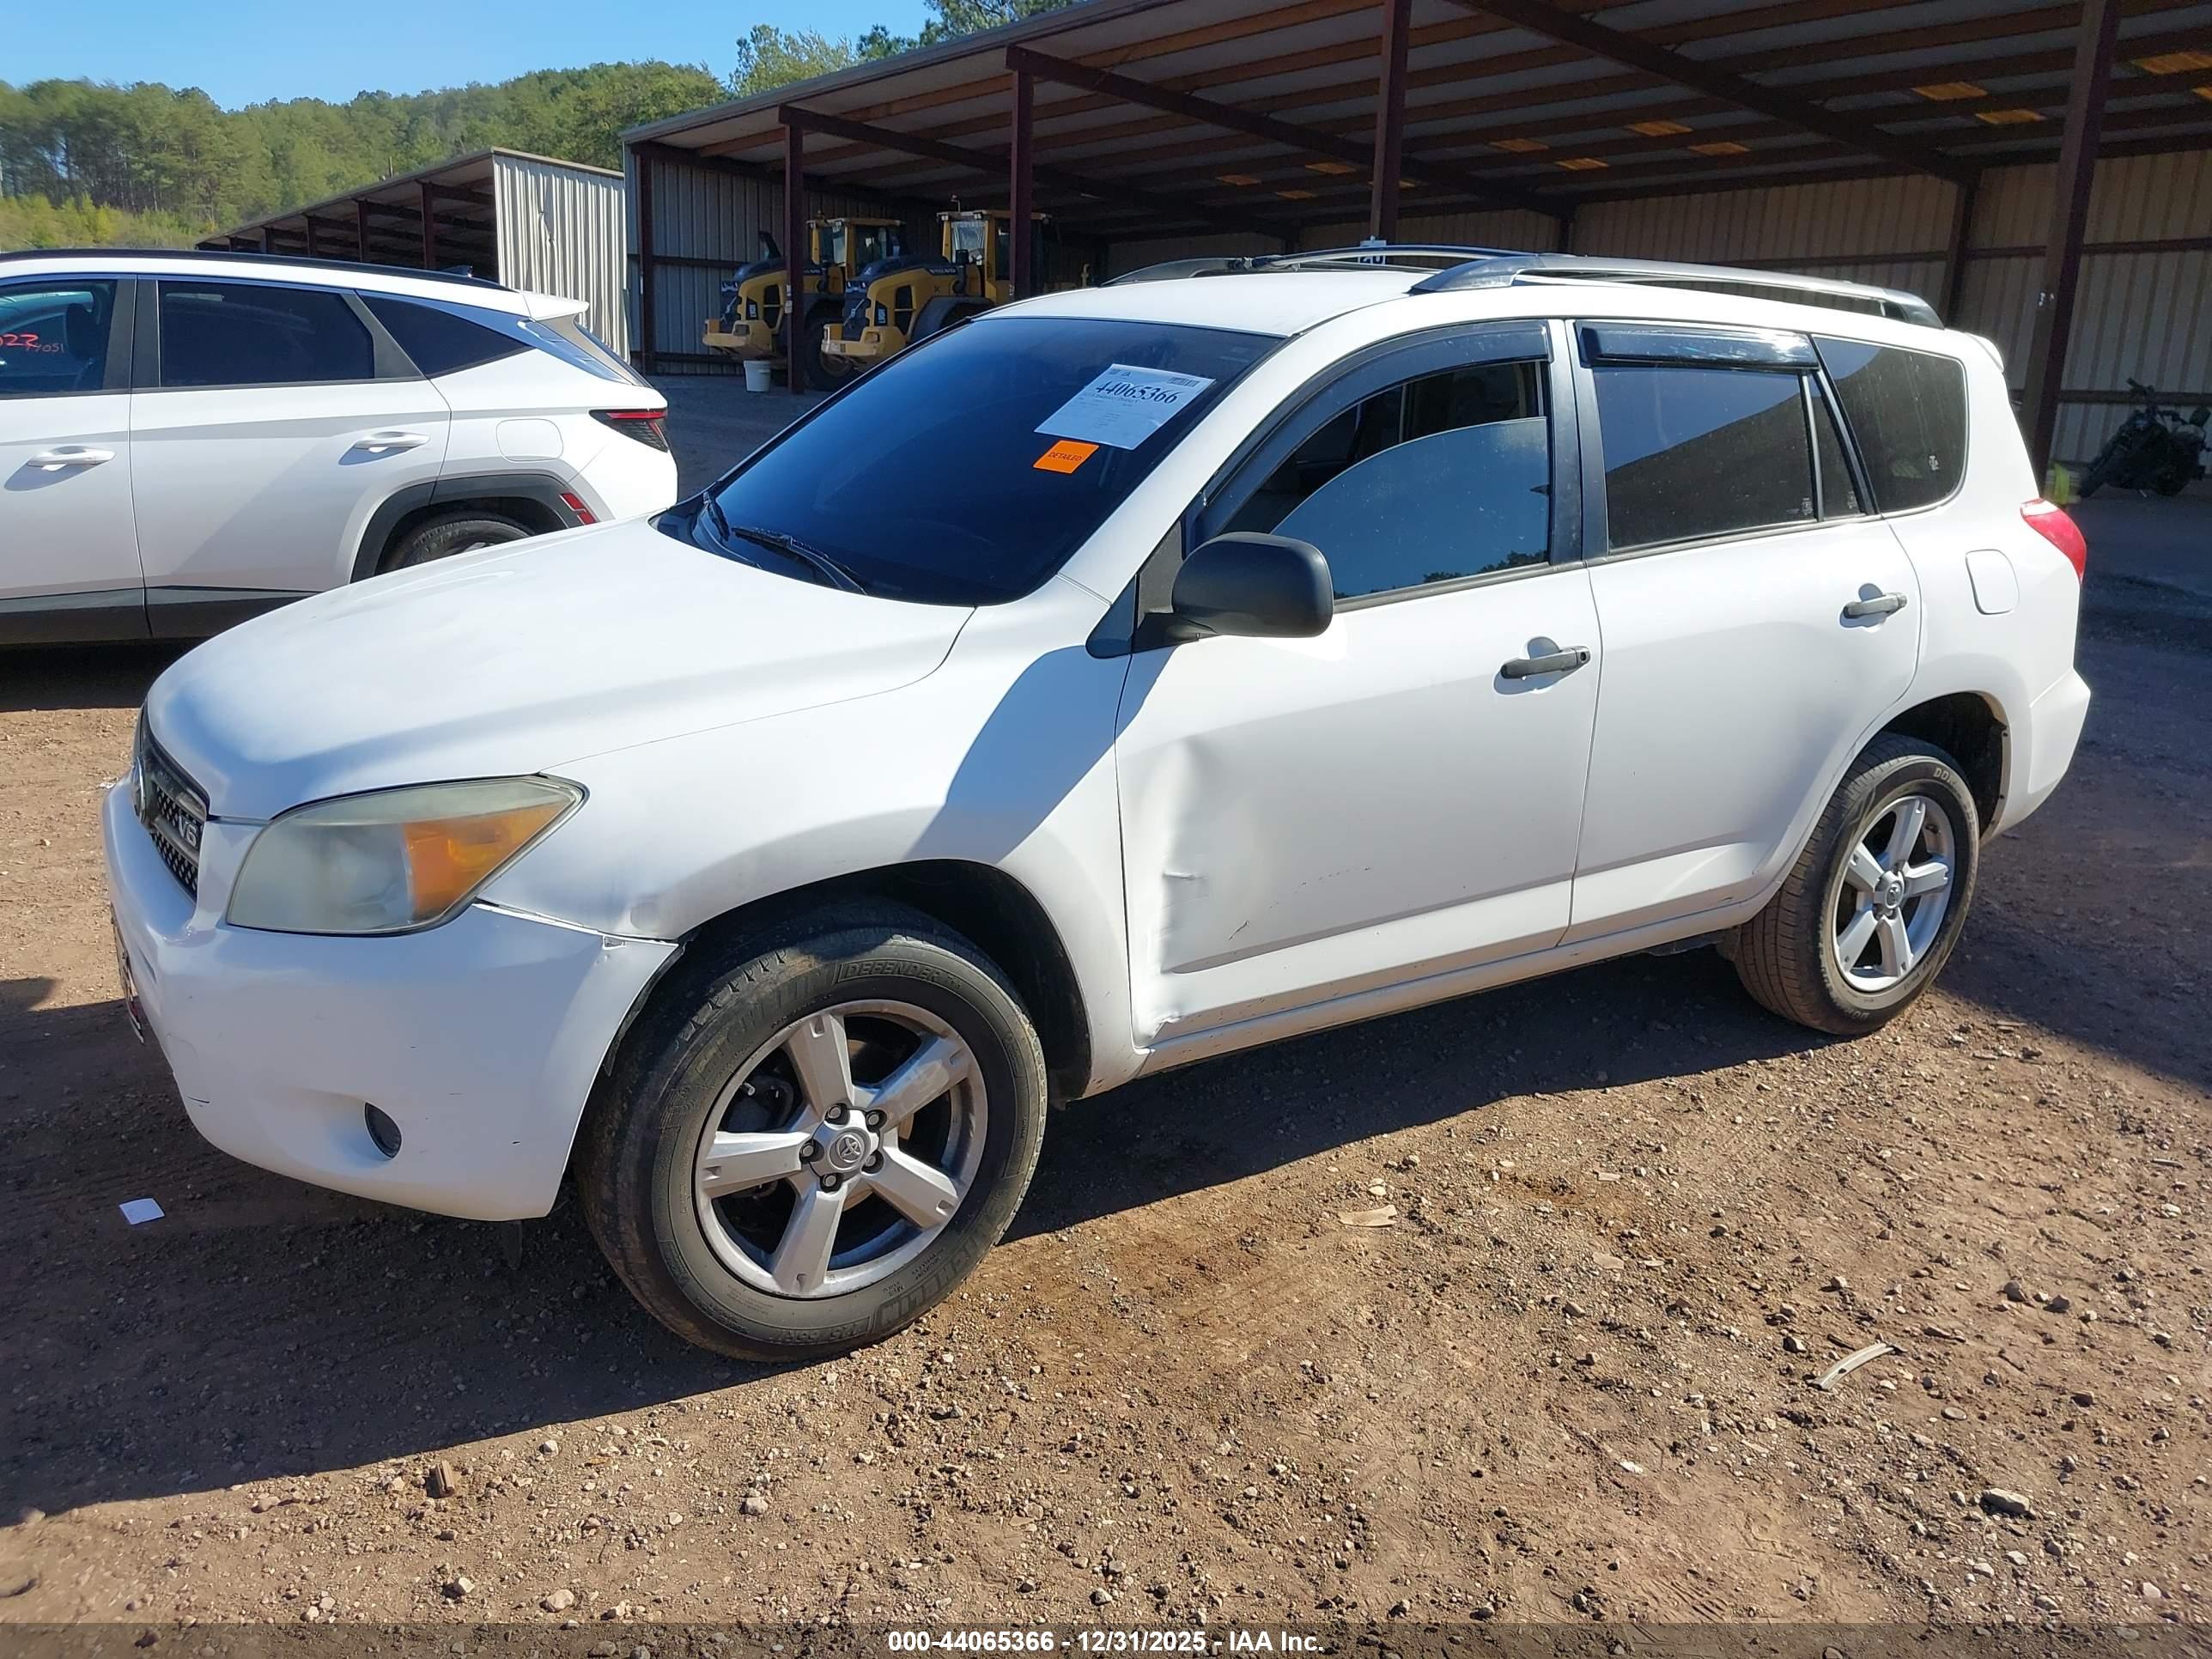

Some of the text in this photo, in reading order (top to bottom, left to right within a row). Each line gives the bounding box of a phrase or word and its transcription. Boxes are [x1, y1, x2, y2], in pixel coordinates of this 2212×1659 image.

[1096, 380, 1183, 404] 44065366
[1048, 452, 1083, 462] DETAILED
[179, 816, 198, 848] V6
[846, 960, 940, 983] DEFENDER
